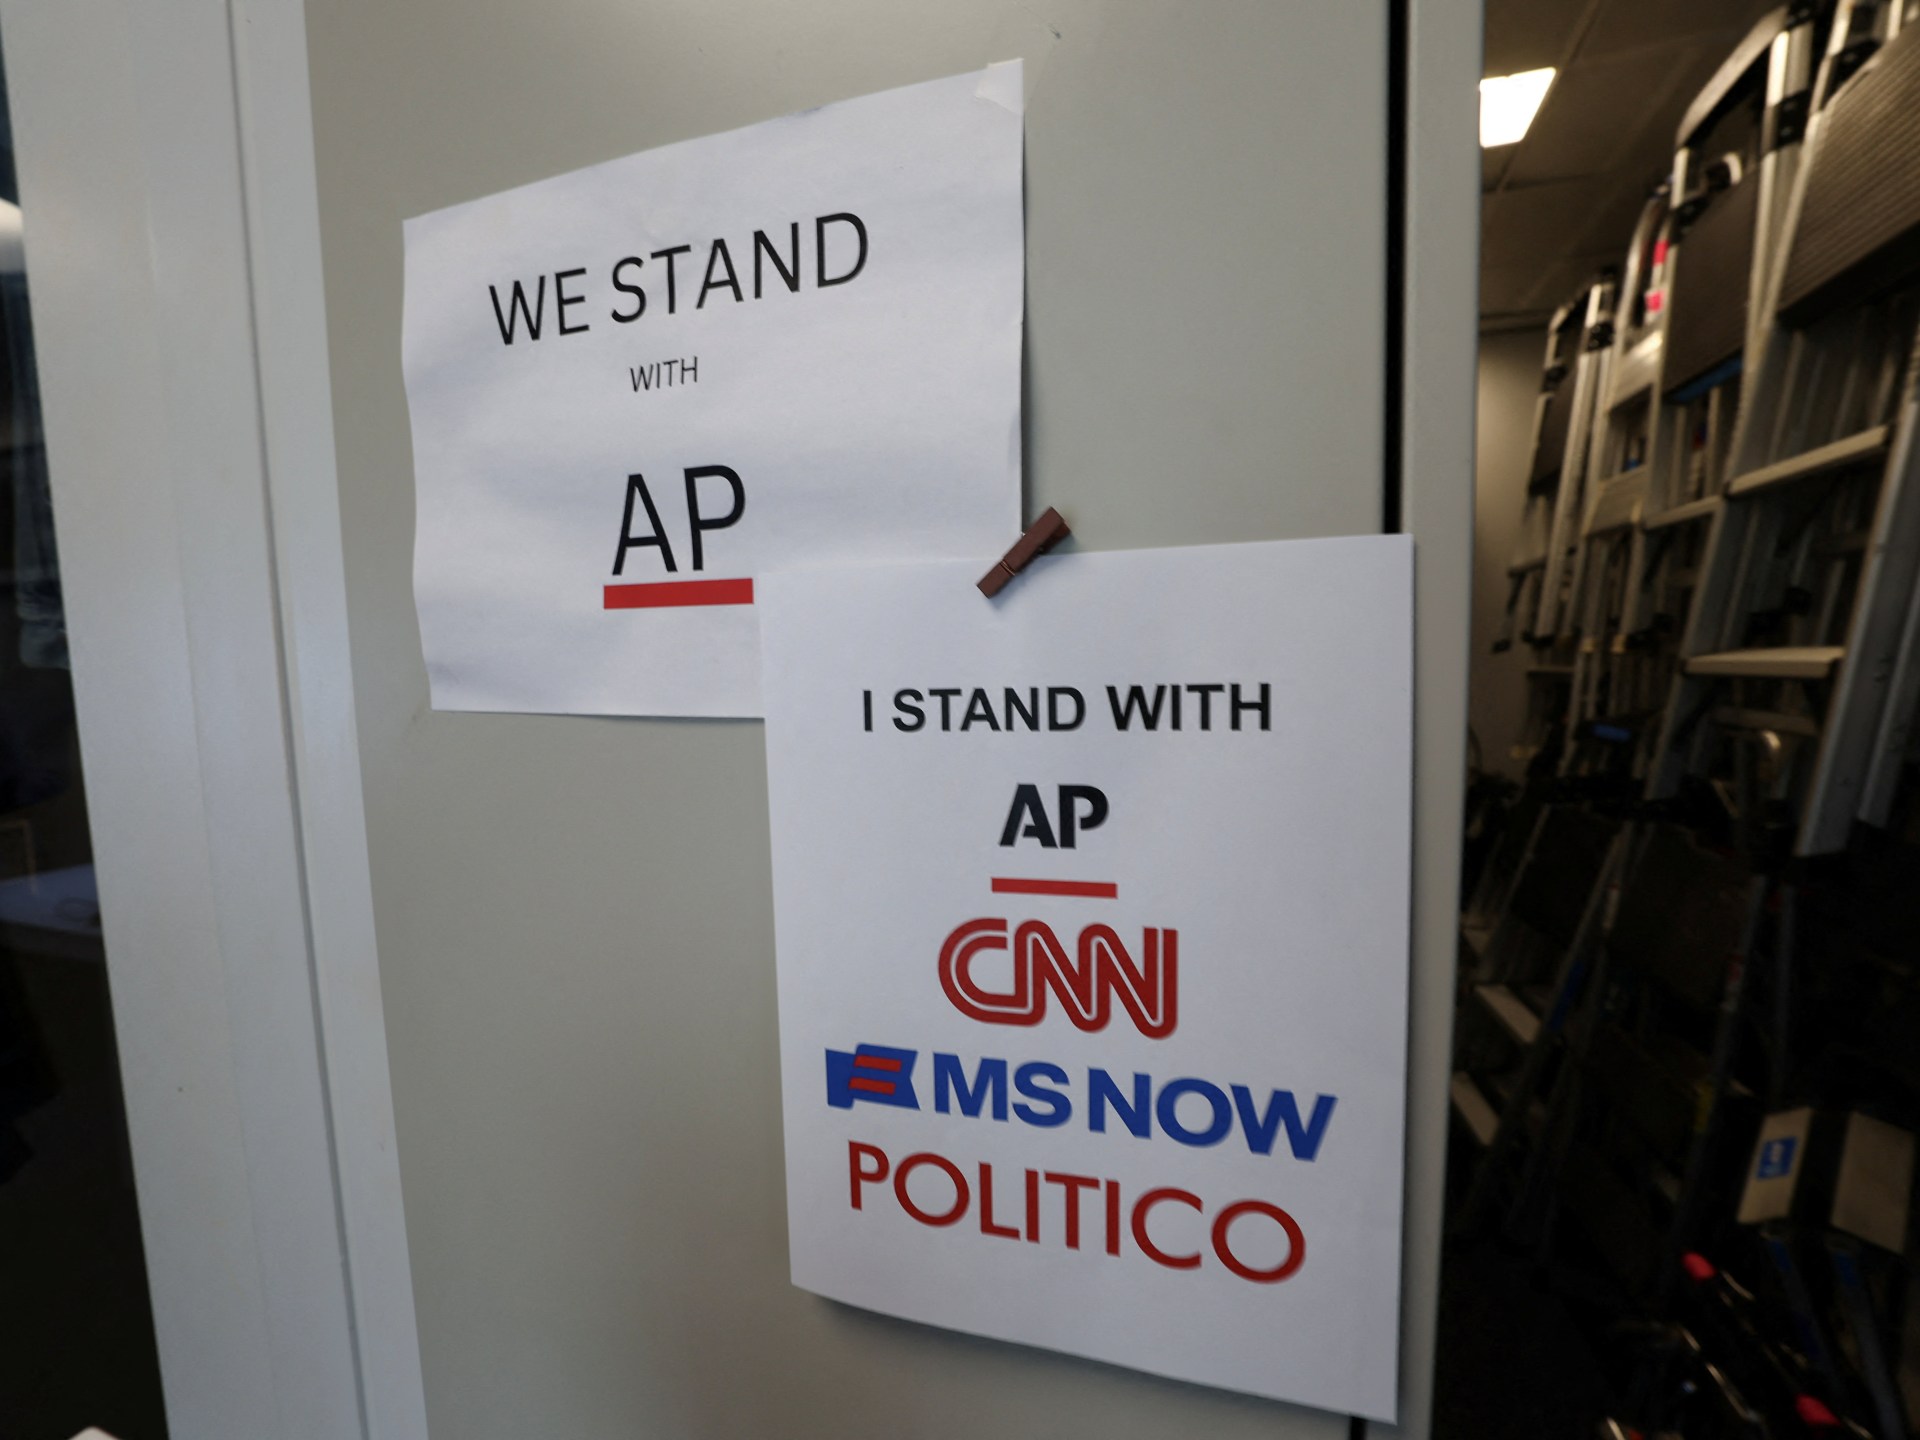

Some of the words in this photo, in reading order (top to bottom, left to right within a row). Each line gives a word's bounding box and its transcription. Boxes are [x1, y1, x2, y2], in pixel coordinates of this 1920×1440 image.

[489, 267, 590, 346] WE
[610, 212, 869, 324] STAND
[629, 355, 699, 393] WITH
[612, 465, 745, 575] AP
[863, 689, 873, 733] I
[893, 687, 1086, 732] STAND
[1106, 683, 1270, 731] WITH
[999, 784, 1109, 849] AP
[938, 918, 1178, 1040] CNN
[933, 1052, 1073, 1128] MS
[1087, 1067, 1337, 1162] NOW
[848, 1140, 1306, 1284] POLITICO
